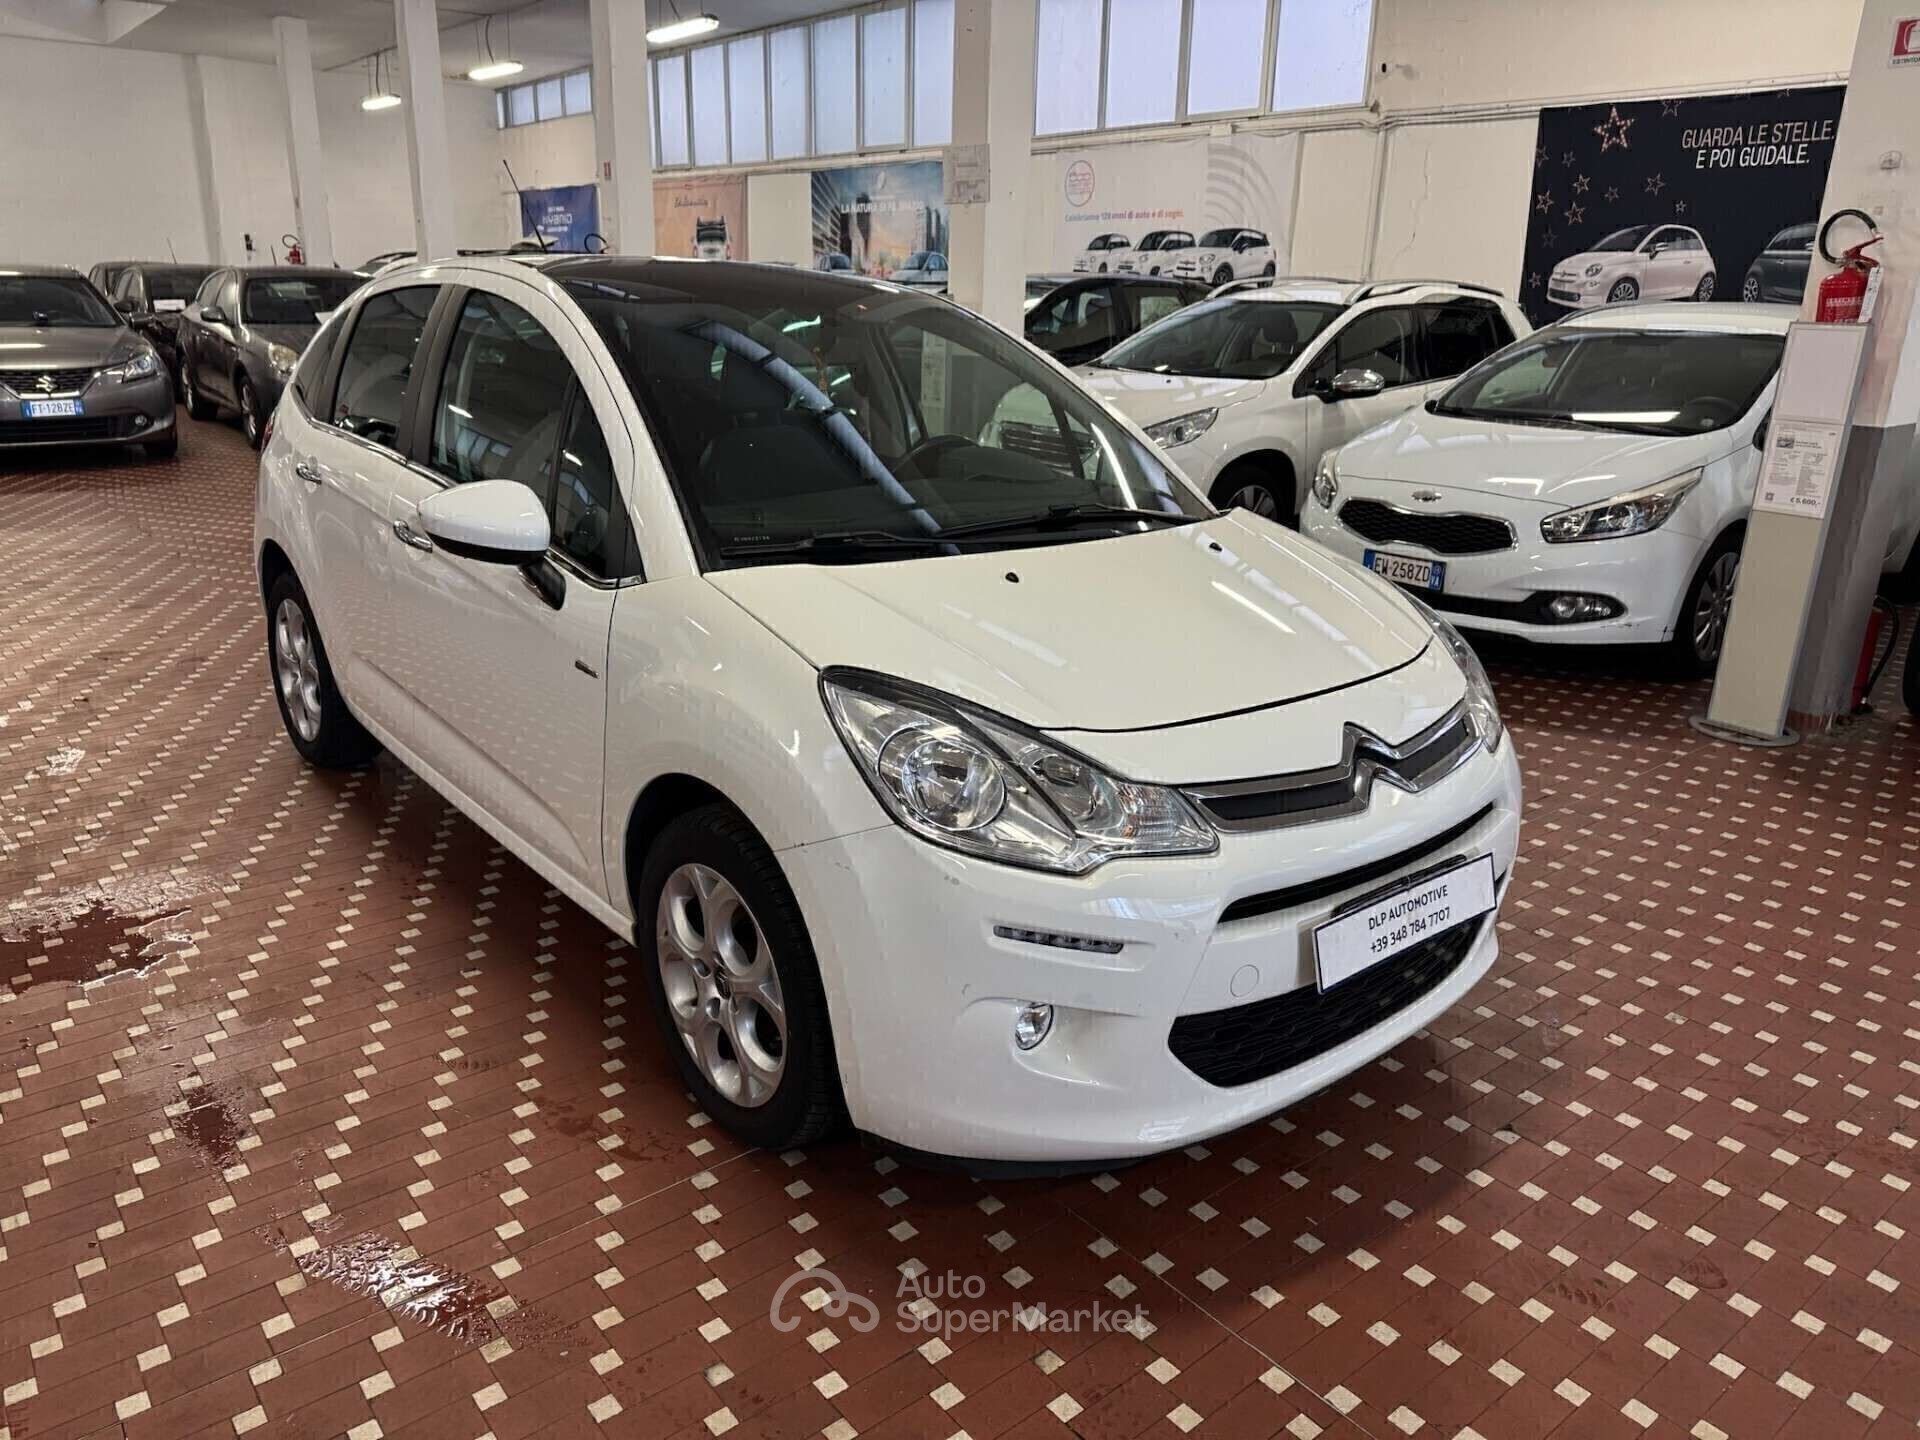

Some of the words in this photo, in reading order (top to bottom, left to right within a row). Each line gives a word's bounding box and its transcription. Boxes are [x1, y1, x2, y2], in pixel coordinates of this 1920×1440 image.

[1682, 126, 1744, 149] GUARDA
[1748, 124, 1769, 145] LE
[1772, 120, 1836, 144] STELLE.
[1696, 150, 1707, 169] E
[1709, 148, 1736, 169] POI
[1739, 144, 1810, 168] GUIDALE.
[1368, 911, 1387, 931] DLP
[1389, 884, 1449, 921] AUTOMOTIVE
[1370, 935, 1389, 953] +39
[1390, 925, 1408, 946] 348
[1409, 917, 1427, 936] 784
[1428, 906, 1450, 928] 7707
